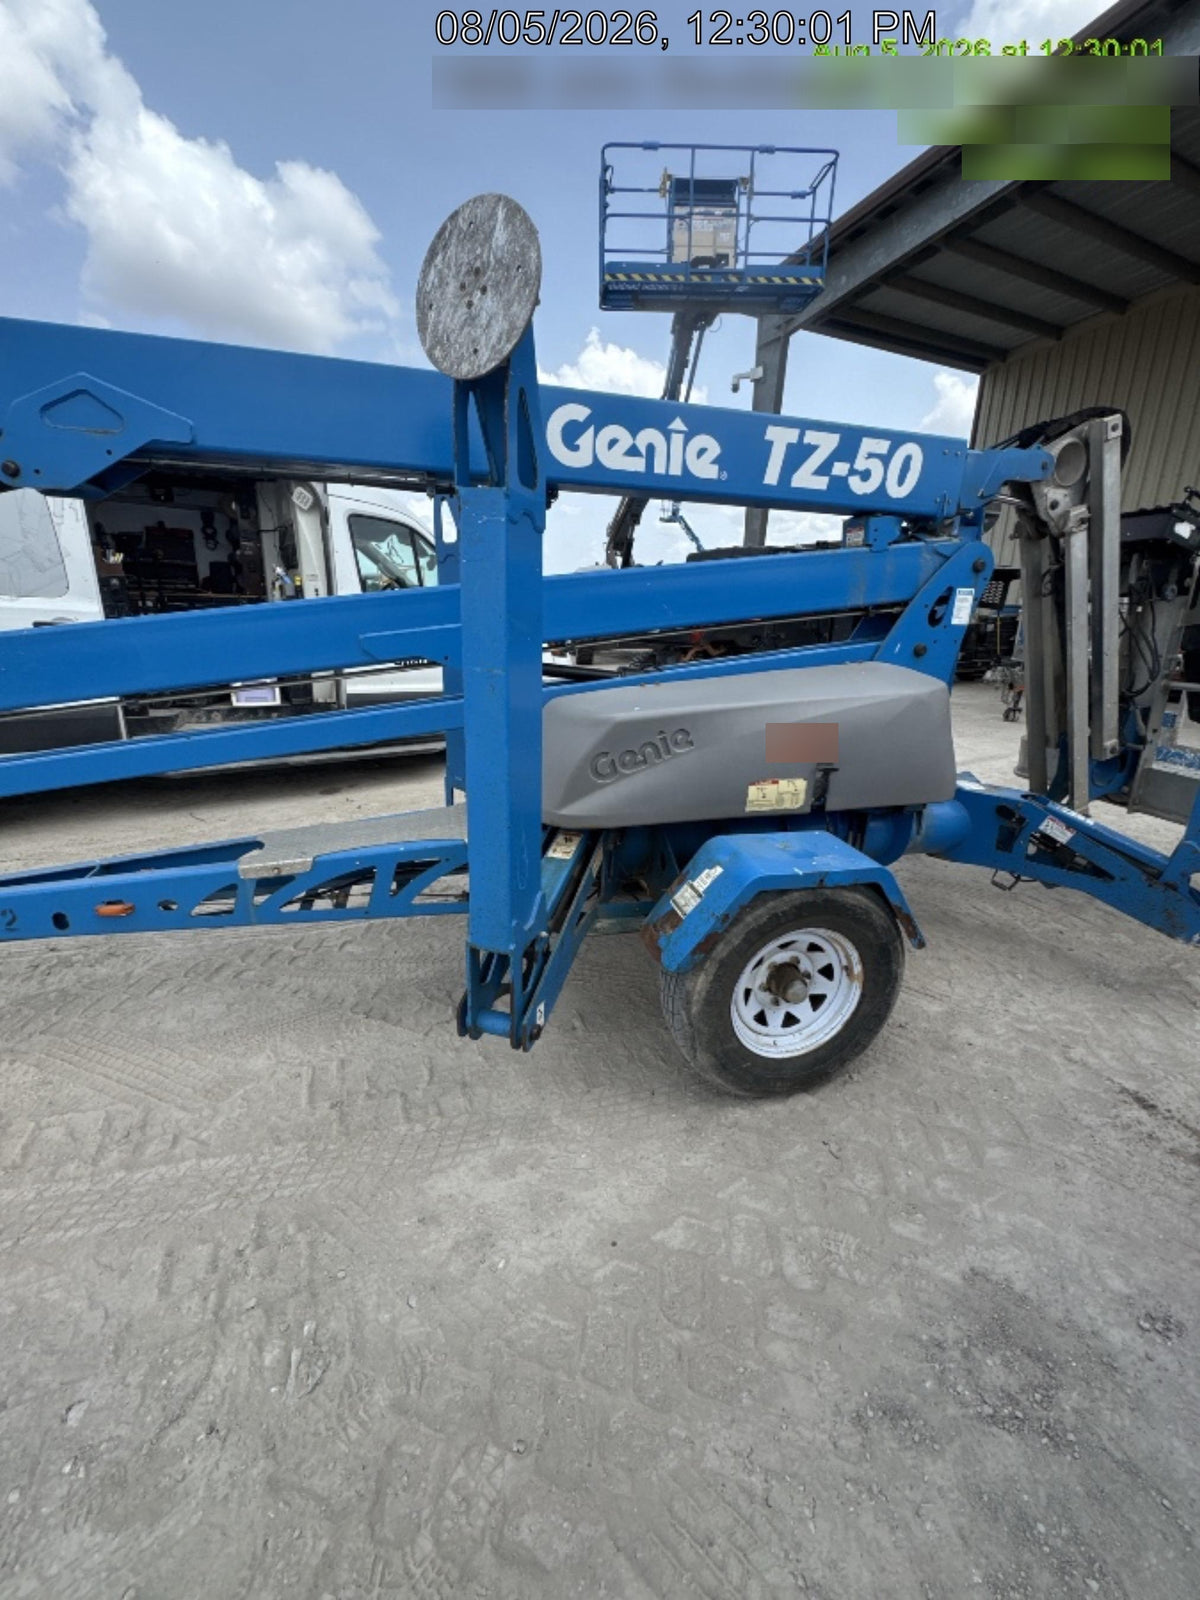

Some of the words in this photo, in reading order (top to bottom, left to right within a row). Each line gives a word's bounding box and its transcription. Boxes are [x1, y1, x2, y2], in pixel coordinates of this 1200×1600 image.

[546, 403, 723, 480] Genie
[762, 425, 924, 498] TZ-50
[589, 728, 695, 783] Genie
